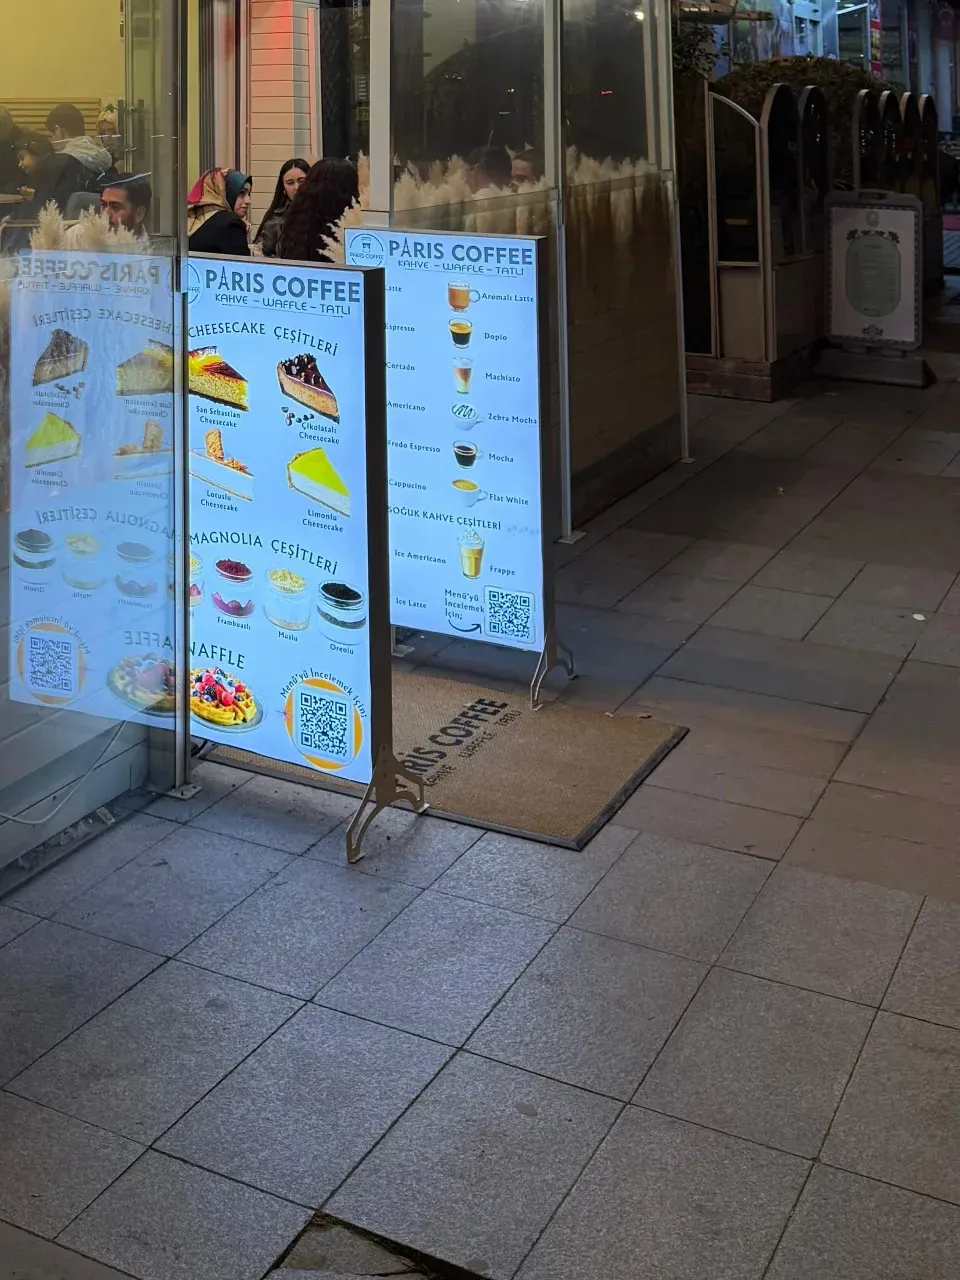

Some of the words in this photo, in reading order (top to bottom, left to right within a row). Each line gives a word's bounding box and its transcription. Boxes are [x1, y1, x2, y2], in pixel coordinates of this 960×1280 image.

[452, 244, 533, 266] COFFEE
[397, 259, 429, 270] KAHVE
[442, 263, 485, 274] WAFFLE
[495, 266, 524, 276] TATLI
[272, 275, 361, 303] COFFEE
[215, 293, 248, 305] KAHVE
[263, 297, 307, 312] WAFFLE
[320, 303, 351, 316] TATLI
[514, 295, 535, 303] Latte
[189, 321, 266, 338] CHEESECAKE
[273, 326, 339, 357] ÇEŞİTLERİ
[196, 405, 208, 415] San
[209, 408, 241, 419] Sebastian
[199, 415, 237, 428] Cheesecake
[511, 416, 537, 425] Mocha
[299, 431, 340, 445] Cheesecake
[410, 442, 441, 453] Espresso
[489, 453, 514, 463] Mocha
[200, 498, 238, 512] Cheesecake
[489, 493, 504, 502] Flat
[506, 495, 529, 506] White
[302, 518, 344, 533] Cheesecake
[422, 511, 454, 523] KAHVE
[456, 515, 501, 531] ÇEŞİTLERİ
[190, 531, 263, 548] MAGNOLIA
[271, 539, 339, 576] ÇEŞİTLERİ
[407, 551, 447, 565] Americano
[490, 565, 516, 577] Frappe
[329, 643, 355, 656] Oreolu
[429, 698, 509, 746] COFFEE
